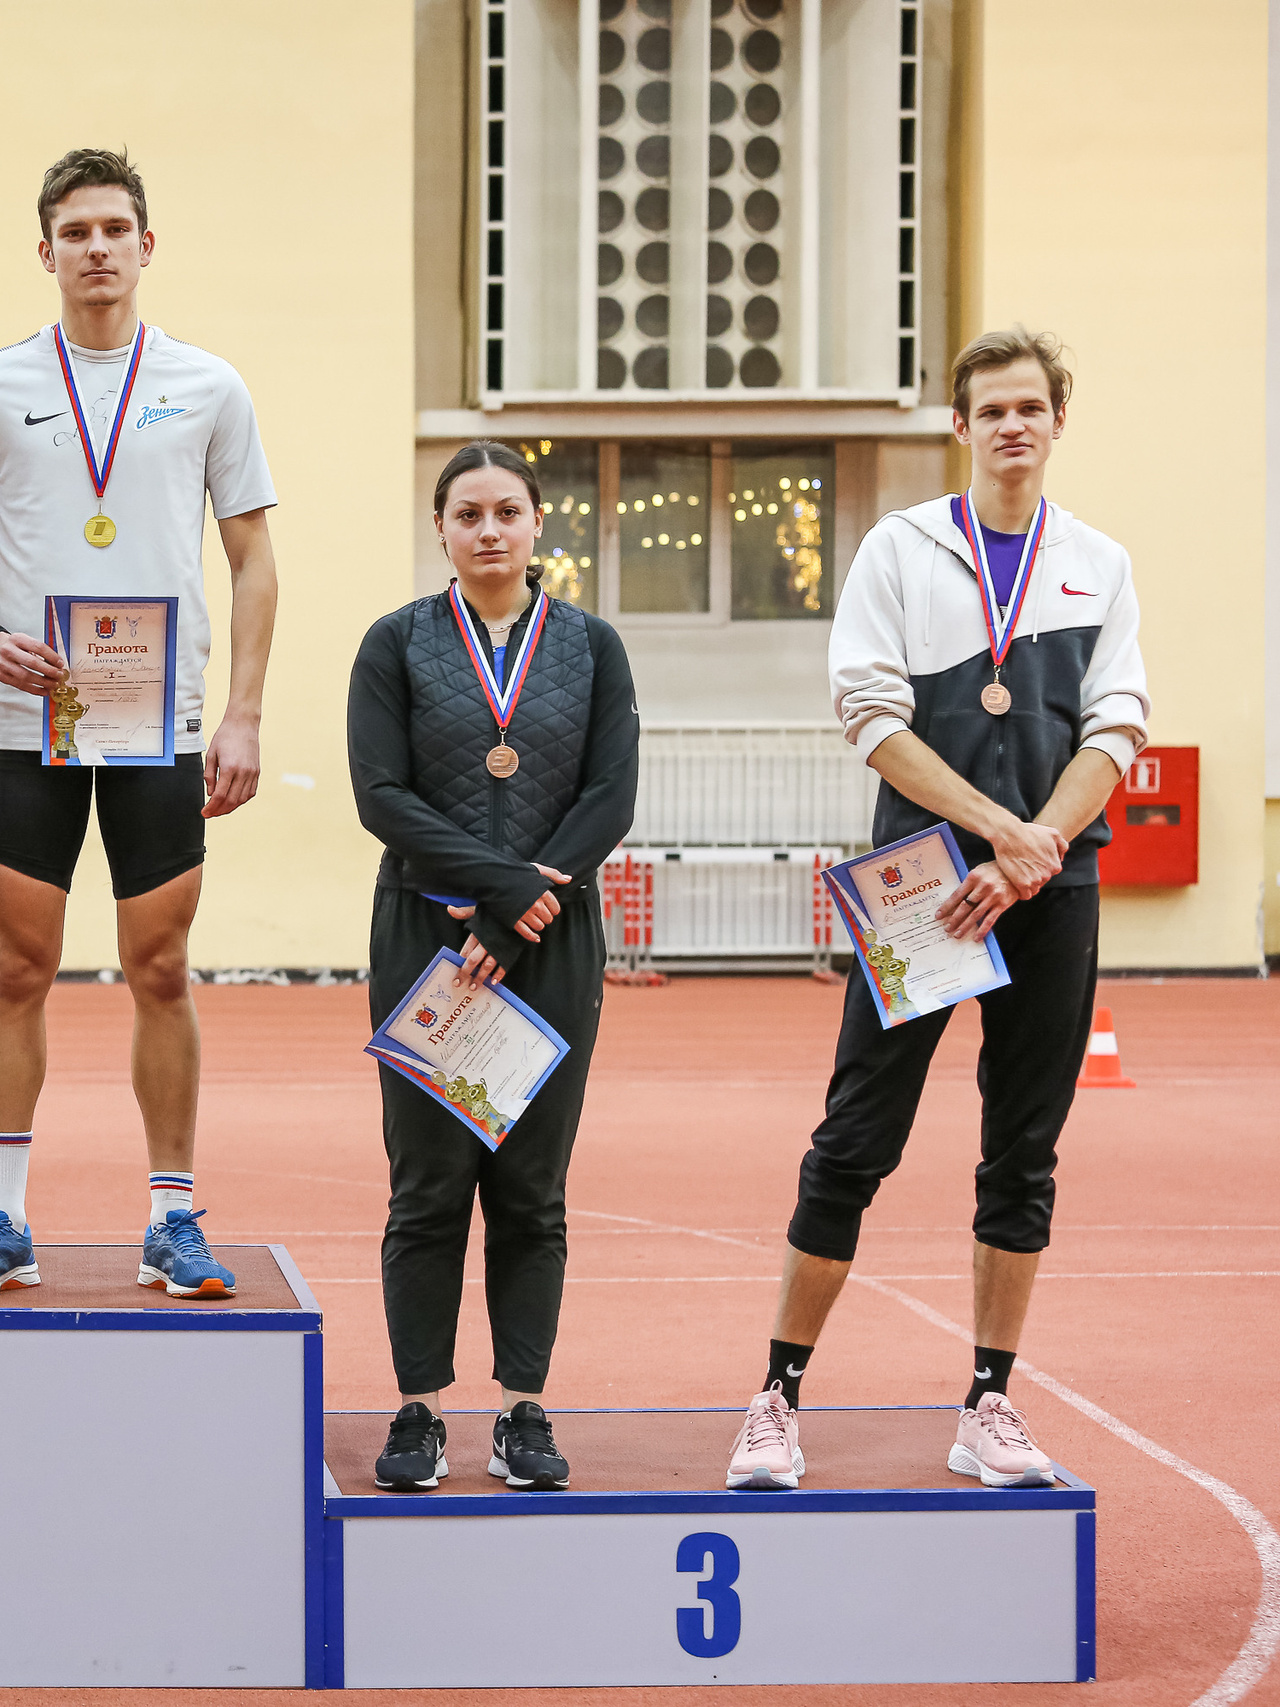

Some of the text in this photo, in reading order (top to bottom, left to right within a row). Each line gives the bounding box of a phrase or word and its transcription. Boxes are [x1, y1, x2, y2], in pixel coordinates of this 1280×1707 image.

[87, 643, 148, 657] Грамота
[881, 877, 942, 907] Грамота
[427, 994, 473, 1046] Грамота
[676, 1532, 741, 1658] 3
